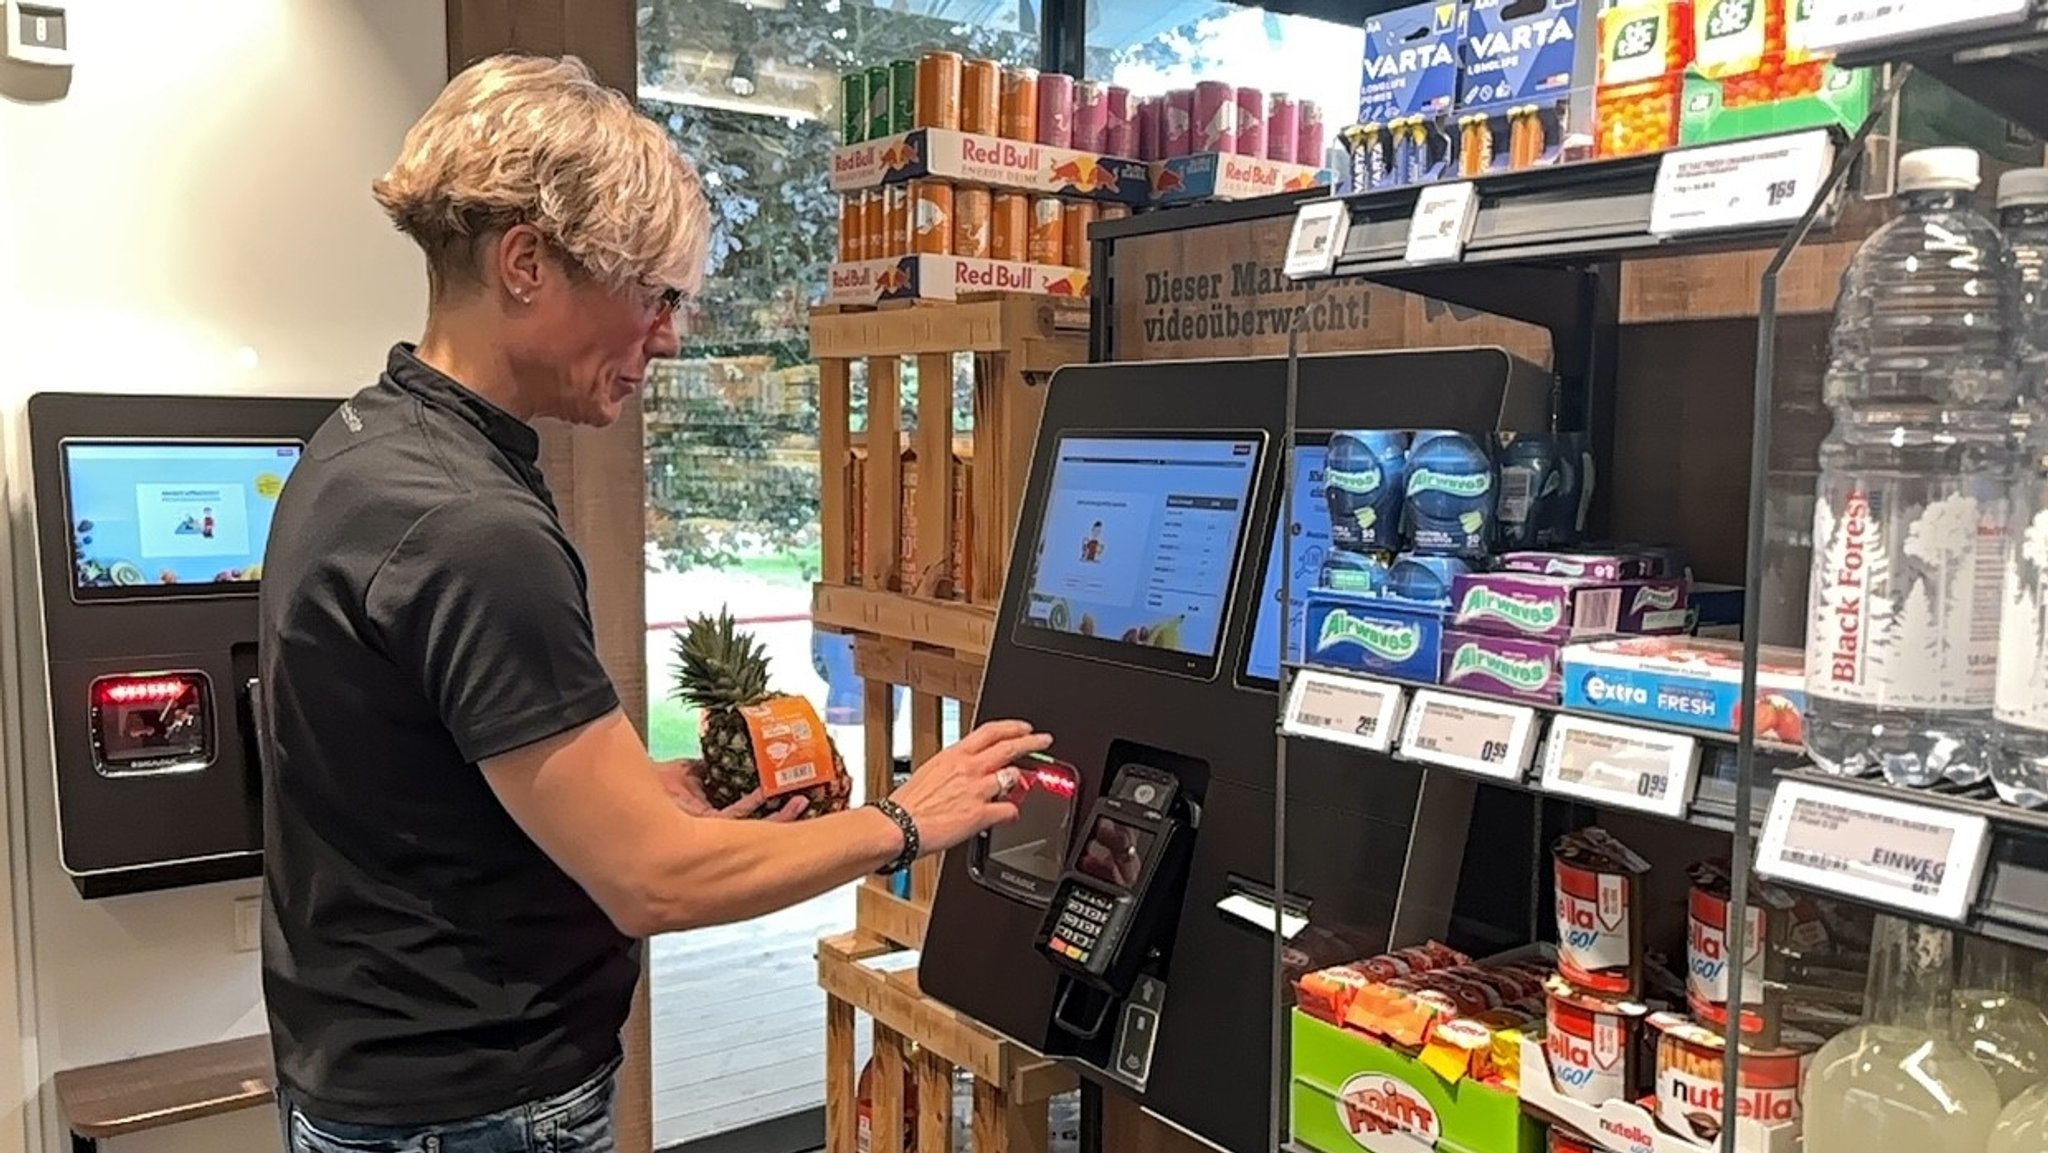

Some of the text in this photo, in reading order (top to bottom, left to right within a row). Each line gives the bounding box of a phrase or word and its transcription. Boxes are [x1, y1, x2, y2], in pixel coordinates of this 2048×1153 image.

[1471, 16, 1574, 59] VARTA
[1363, 42, 1453, 80] VARTA
[1467, 55, 1519, 76] LONGLIFE
[835, 146, 874, 172] Red Bull
[962, 138, 1040, 171] Red Bull
[1224, 161, 1251, 182] Red
[1252, 165, 1278, 187] Bull
[832, 267, 871, 288] Red Bull
[955, 261, 1032, 289] Red Bull
[1144, 269, 1222, 305] Dieser
[1144, 291, 1371, 343] videoüberwacht!
[1411, 471, 1485, 490] Airwaves
[1465, 588, 1555, 622] Airwaves
[1326, 612, 1413, 651] Airwaves
[1831, 597, 1860, 685] Black
[1455, 646, 1544, 682] Airwaves
[1587, 676, 1647, 705] extra
[1657, 692, 1716, 716] FRESH
[1872, 848, 1946, 877] EINWEG
[1599, 1118, 1654, 1147] nutella
